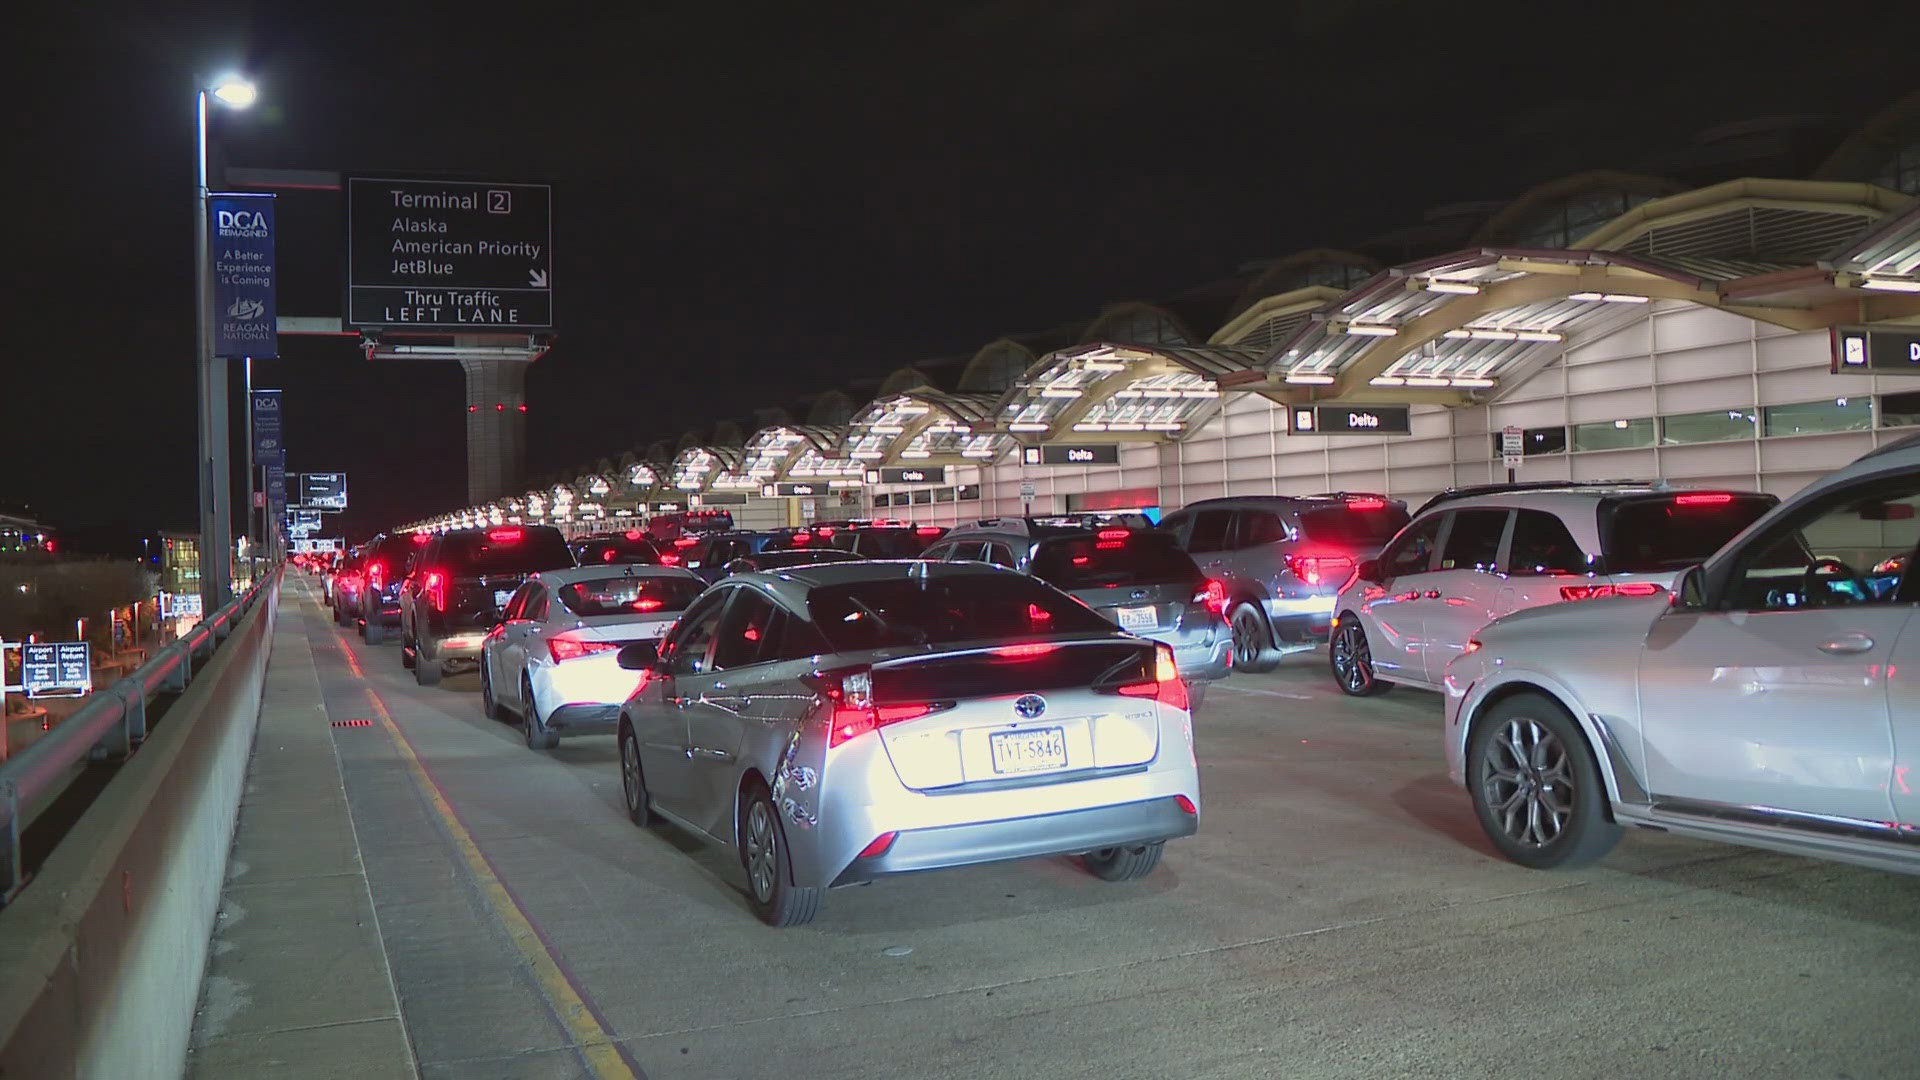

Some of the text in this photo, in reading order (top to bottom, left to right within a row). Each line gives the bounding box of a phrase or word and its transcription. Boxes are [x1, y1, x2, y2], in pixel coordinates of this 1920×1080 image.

[390, 190, 506, 210] Terminal 2
[218, 210, 268, 230] DCA
[392, 218, 448, 233] Alaska
[219, 230, 268, 238] REIMAGINED
[224, 250, 264, 260] A Better
[392, 239, 540, 260] American Priority
[216, 262, 272, 274] Experience
[392, 260, 454, 275] JetBlue
[222, 275, 270, 287] is Coming
[404, 290, 500, 306] Thru Traffic
[385, 307, 518, 323] LEFT LANE
[223, 324, 270, 332] REAGAN
[223, 332, 270, 340] NATIONAL
[1349, 413, 1378, 427] Delta
[1068, 449, 1094, 460] Delta
[901, 472, 924, 480] Delta
